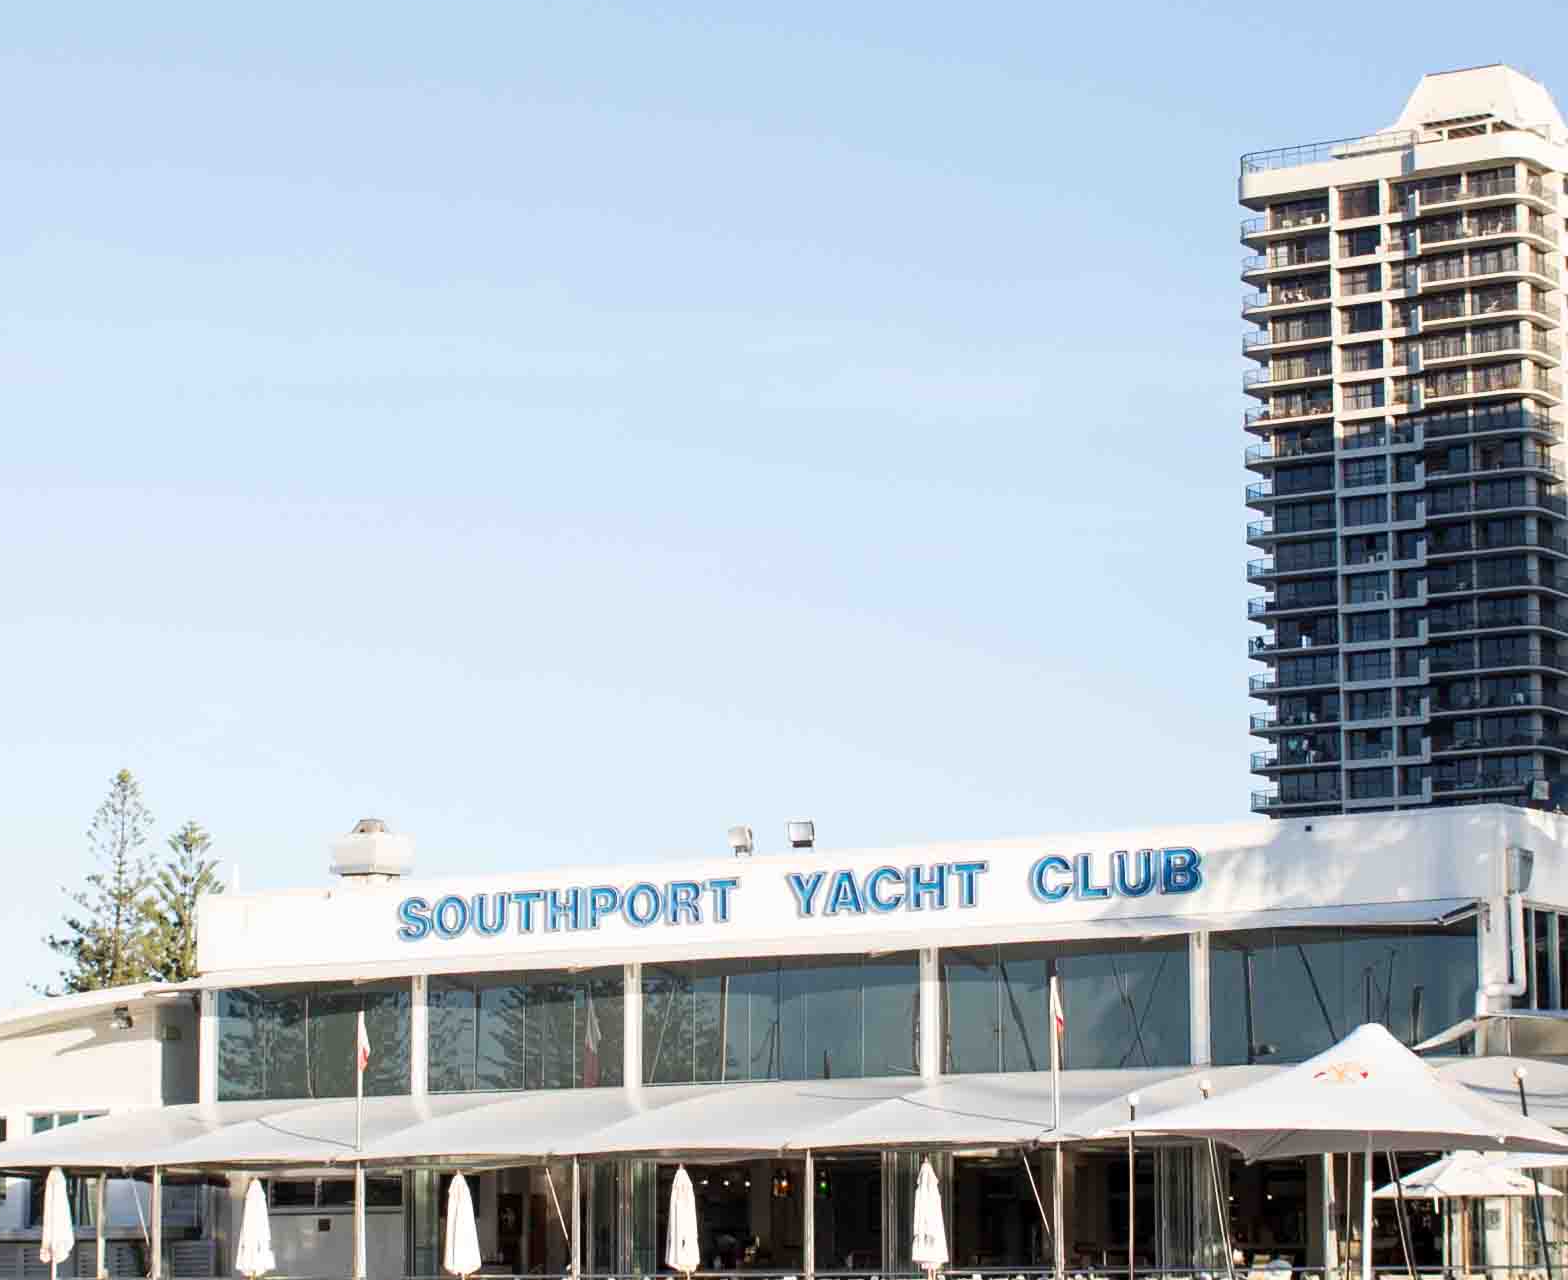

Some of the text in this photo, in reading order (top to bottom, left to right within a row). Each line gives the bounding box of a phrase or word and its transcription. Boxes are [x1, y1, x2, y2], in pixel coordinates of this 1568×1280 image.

[398, 847, 1202, 941] SOUTHPORT YACHT CLUB
